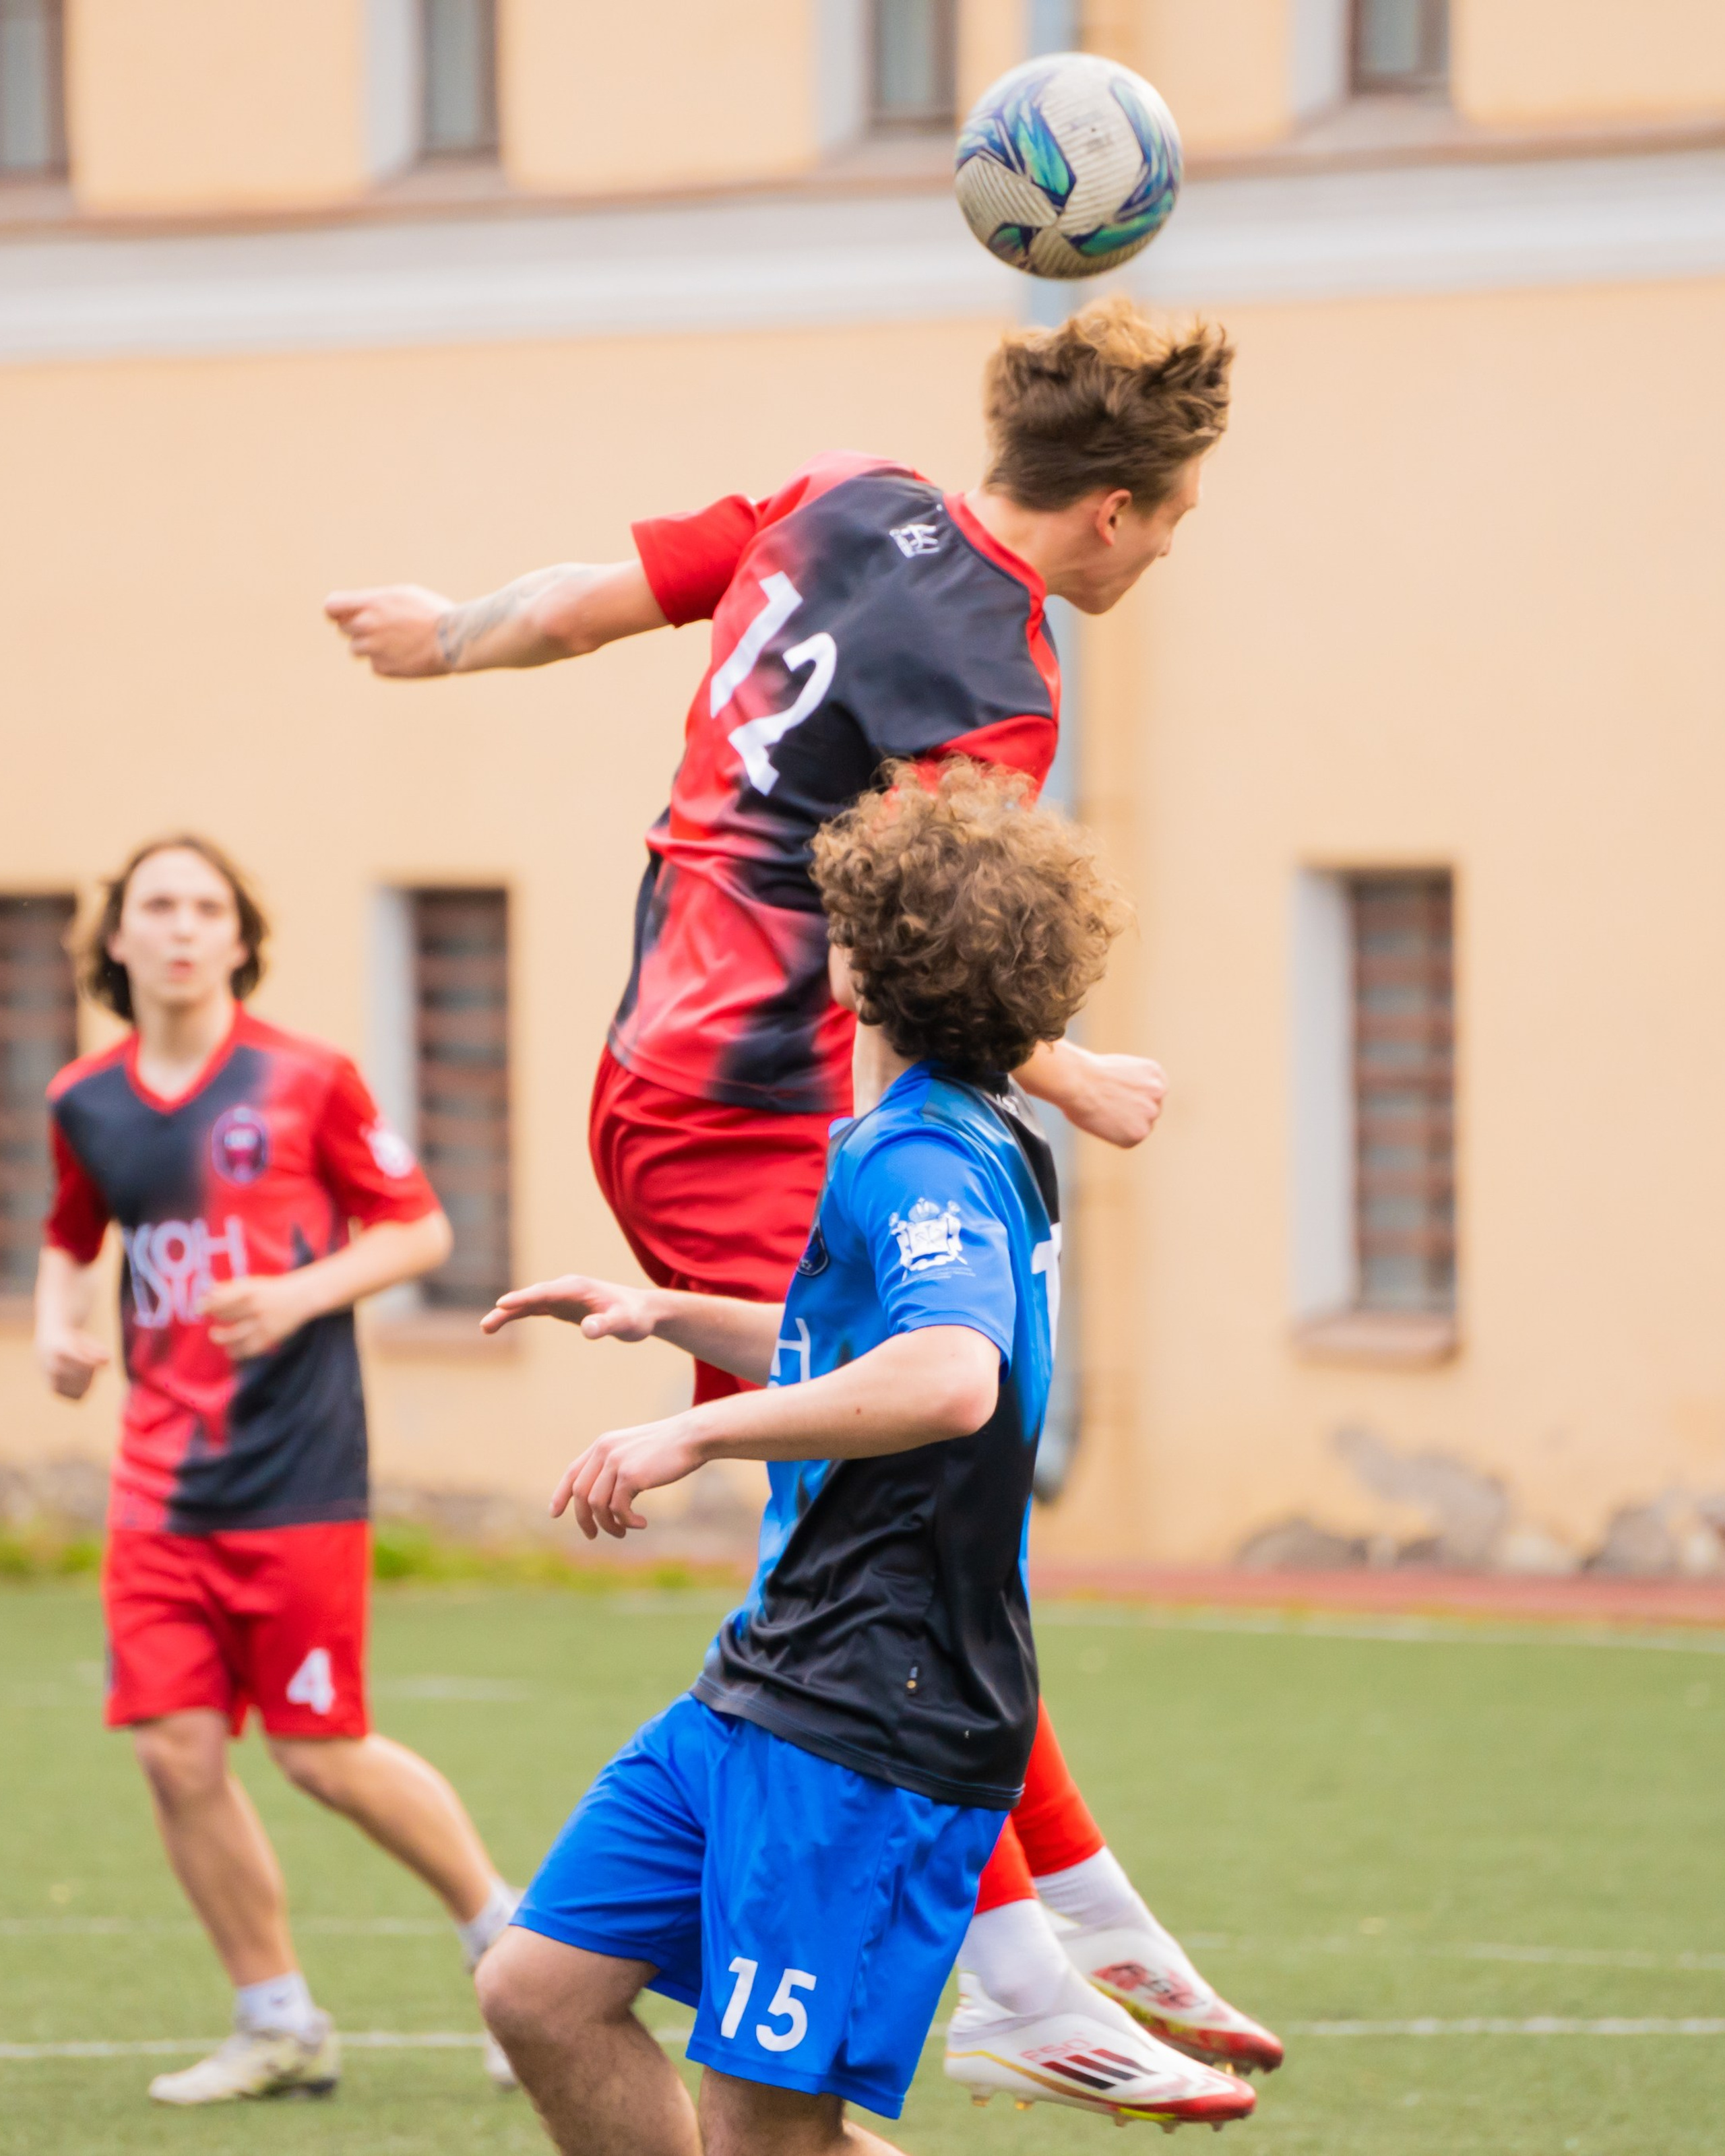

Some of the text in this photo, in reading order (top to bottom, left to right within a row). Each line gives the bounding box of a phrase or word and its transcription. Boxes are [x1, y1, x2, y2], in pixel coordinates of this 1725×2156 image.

[710, 571, 837, 796] 12
[286, 1648, 336, 1715] 4
[720, 1956, 817, 2052] 15
